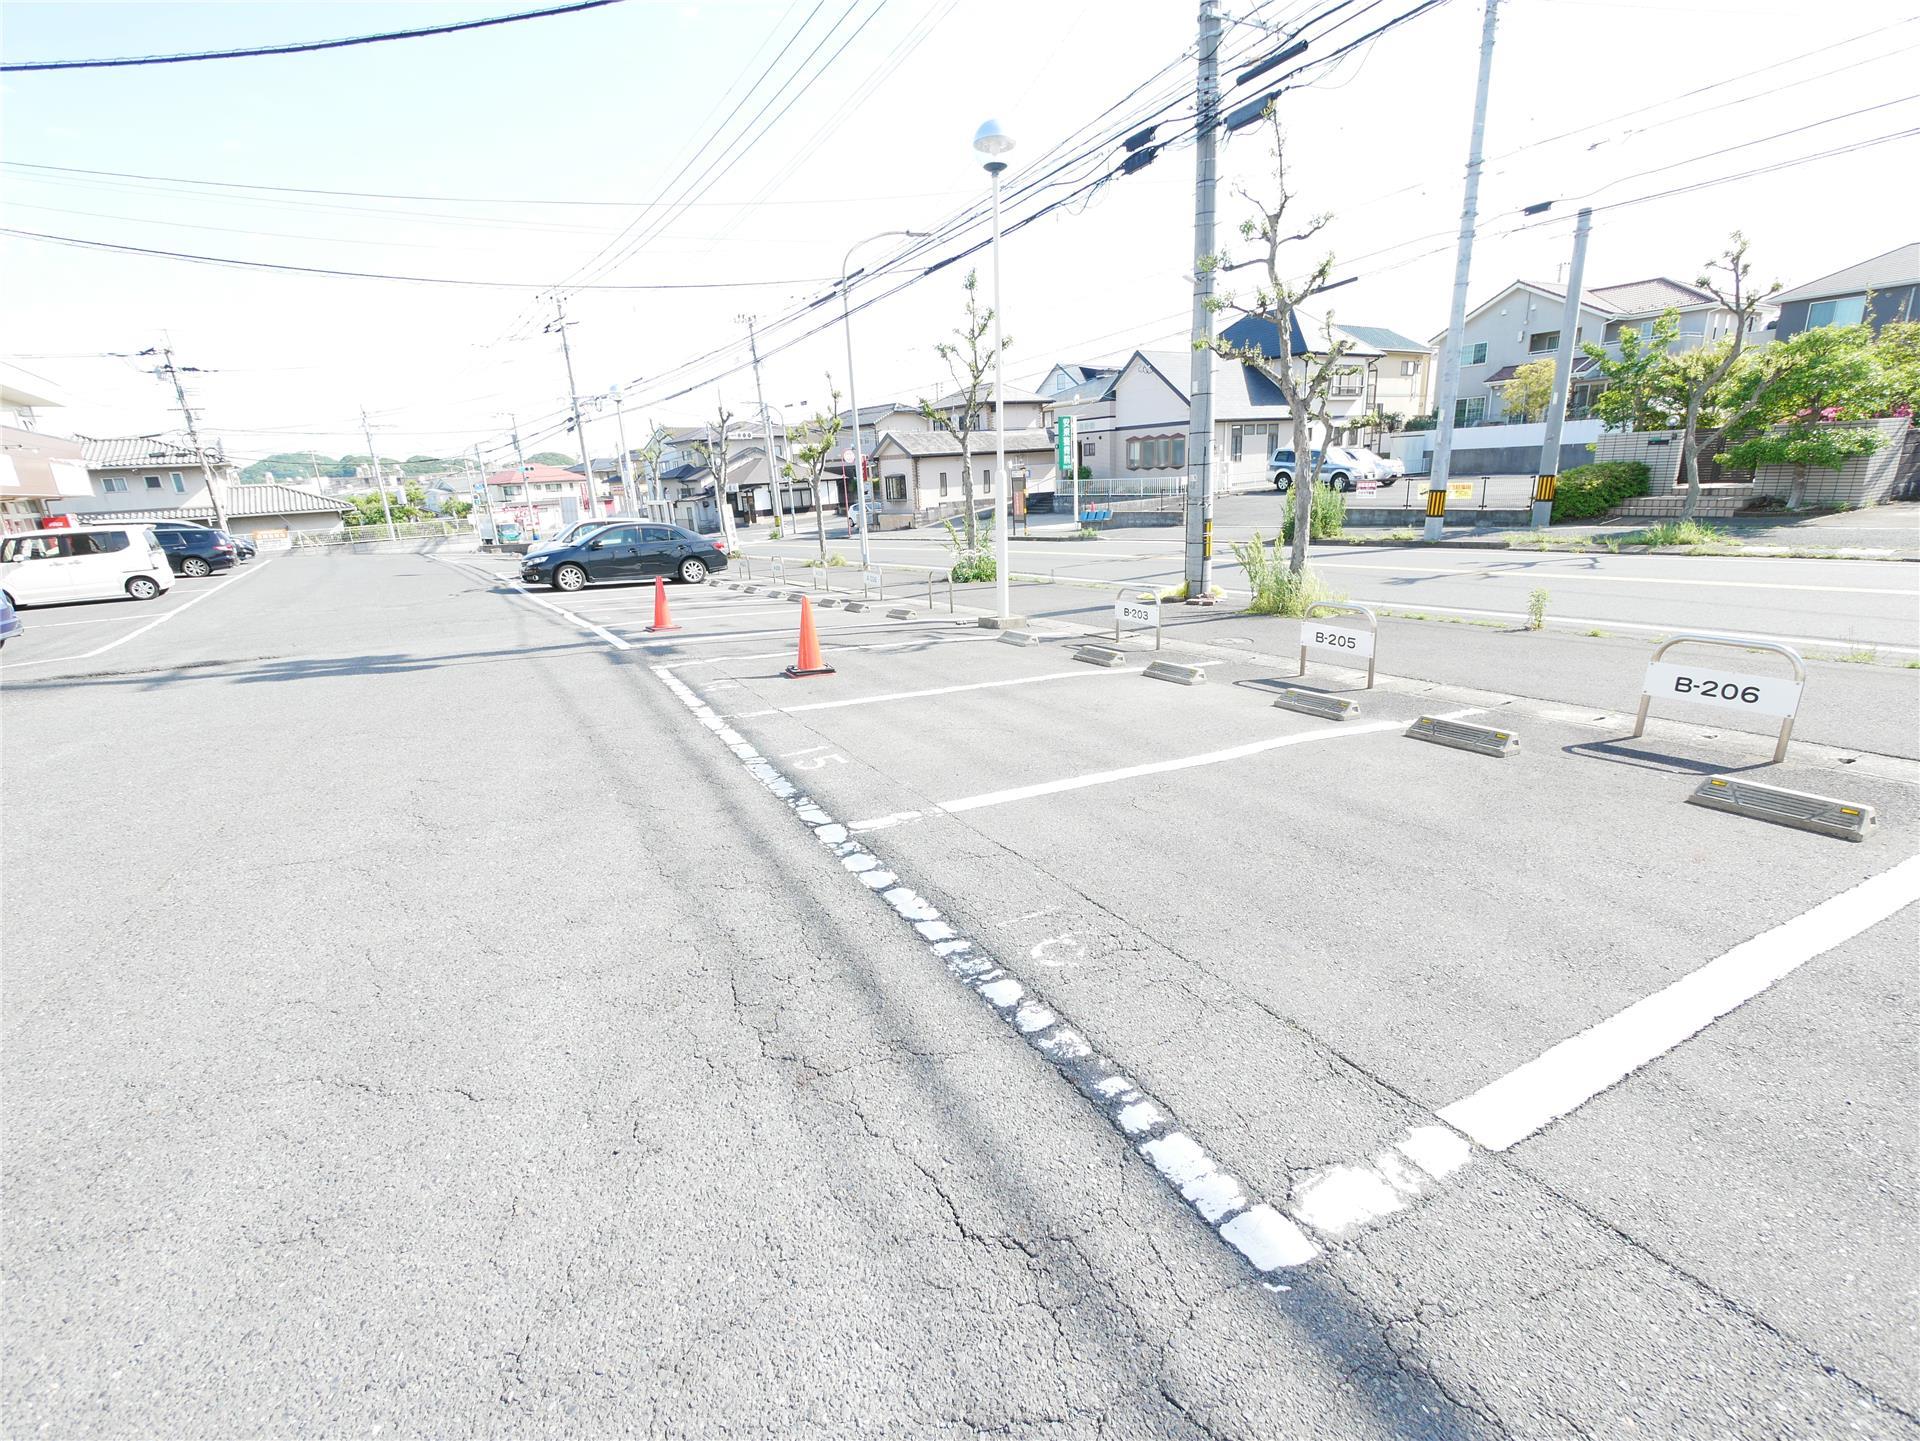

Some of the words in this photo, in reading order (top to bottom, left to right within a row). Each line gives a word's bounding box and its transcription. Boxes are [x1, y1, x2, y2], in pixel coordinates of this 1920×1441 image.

[1123, 607, 1149, 621] B-203
[1315, 631, 1357, 649] B-205
[1674, 676, 1761, 704] B-206
